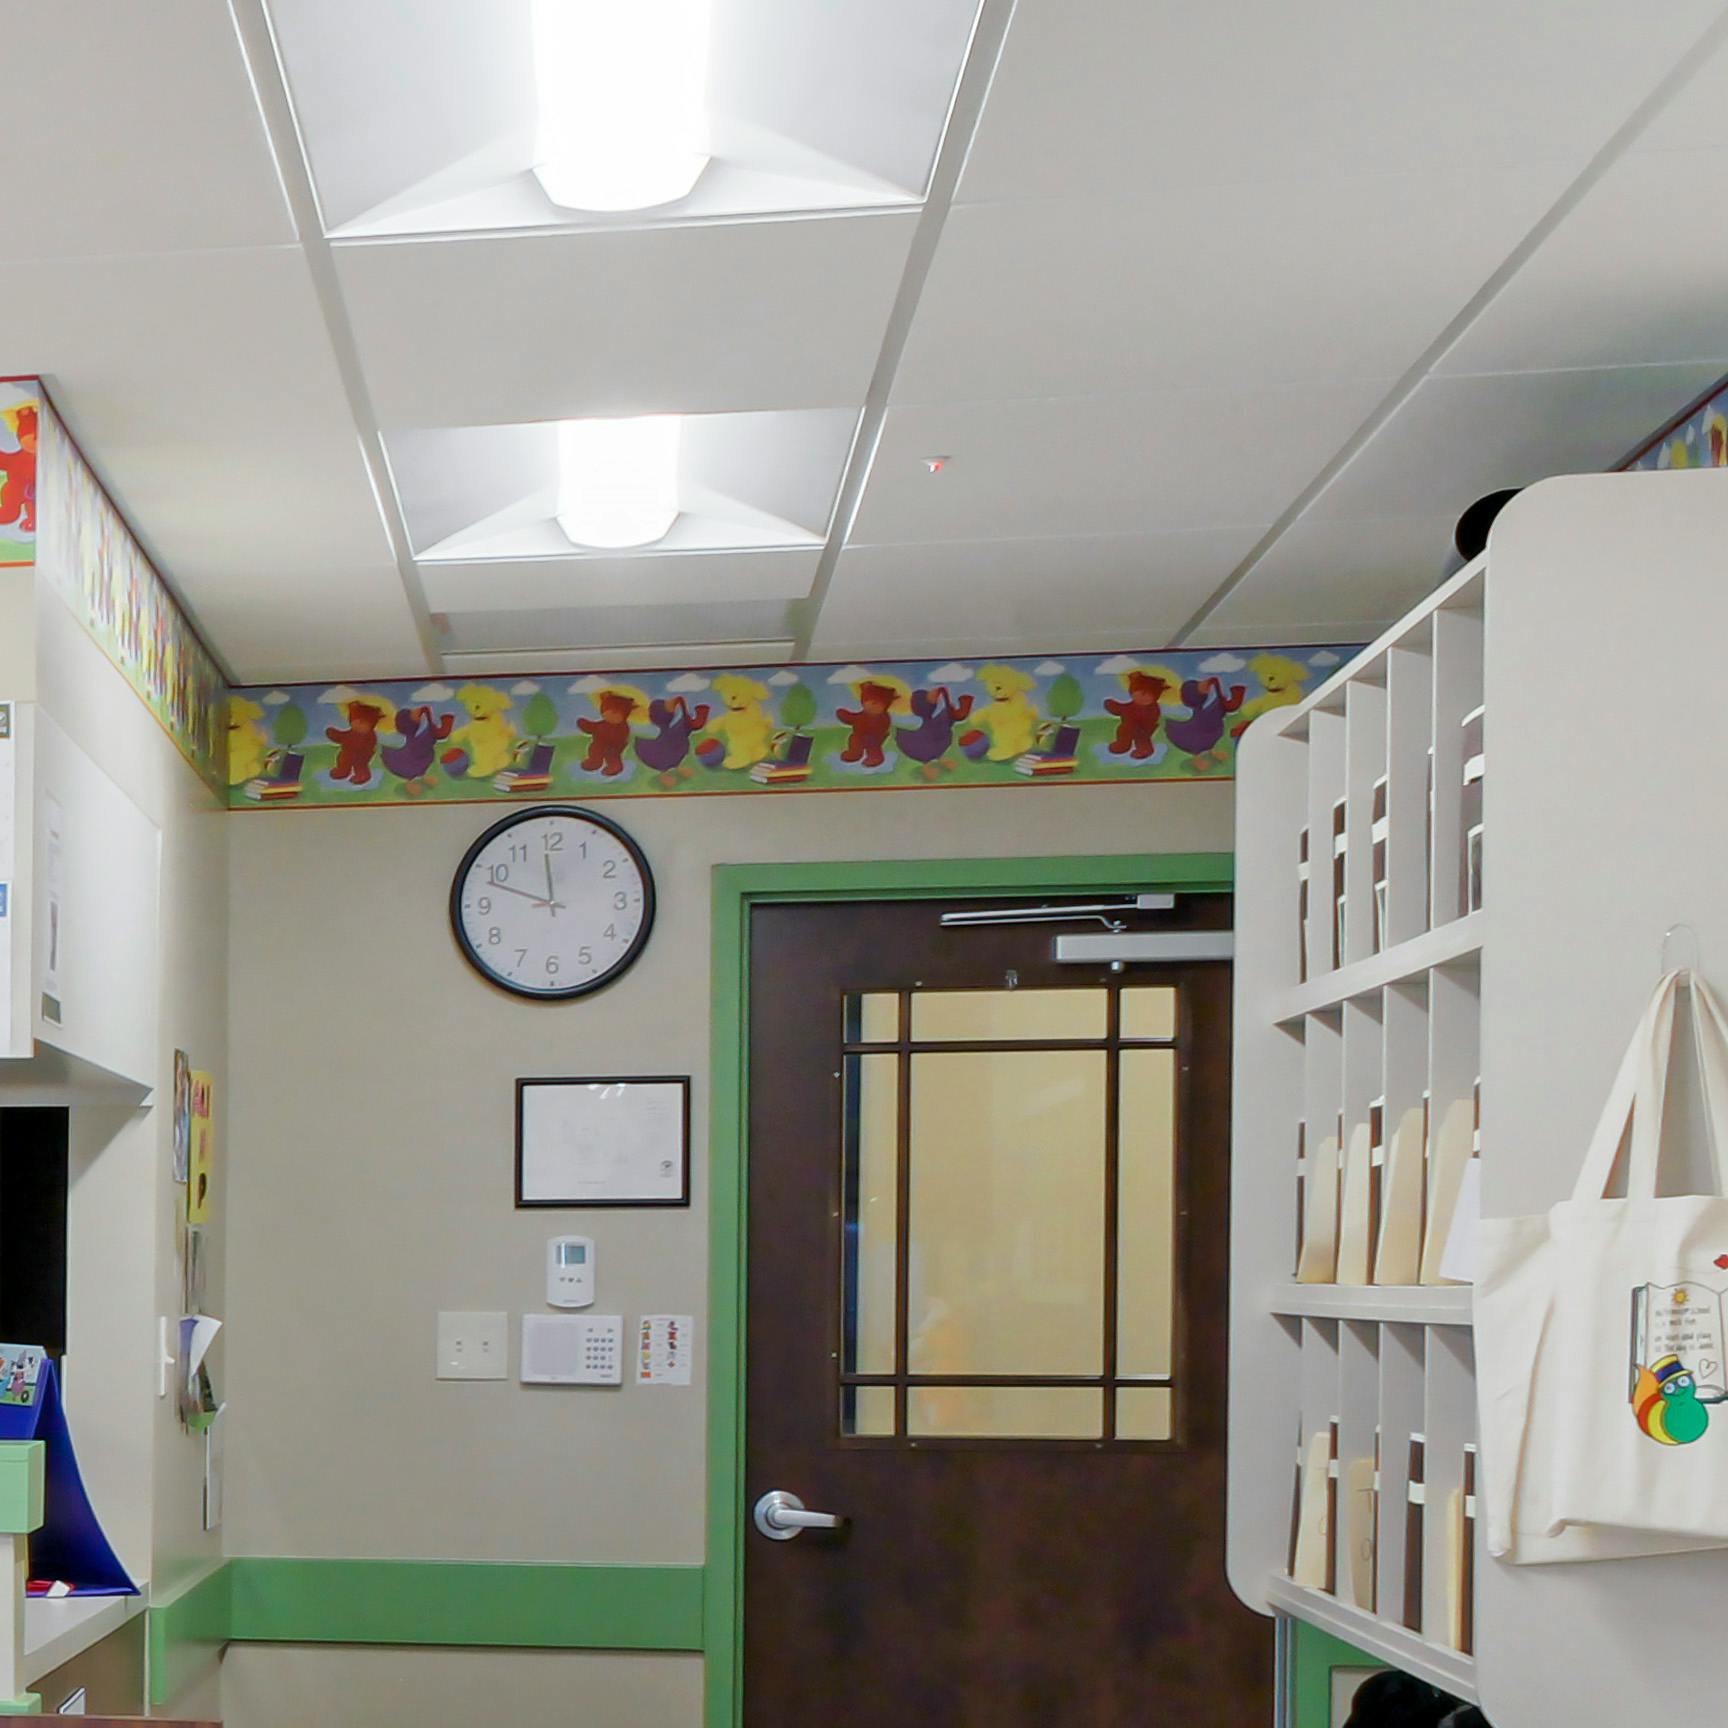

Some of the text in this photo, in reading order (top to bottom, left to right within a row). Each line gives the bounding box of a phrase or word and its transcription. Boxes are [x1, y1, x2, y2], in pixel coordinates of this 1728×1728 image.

[541, 832, 564, 852] 12
[578, 841, 587, 860] 1
[508, 843, 528, 863] 11
[487, 863, 509, 885] 10
[602, 860, 617, 879] 2
[477, 896, 492, 916] 9
[613, 891, 627, 911] 3
[488, 926, 502, 945] 8
[603, 923, 617, 941] 4
[514, 948, 529, 968] 7
[545, 955, 559, 974] 6
[578, 946, 592, 965] 5
